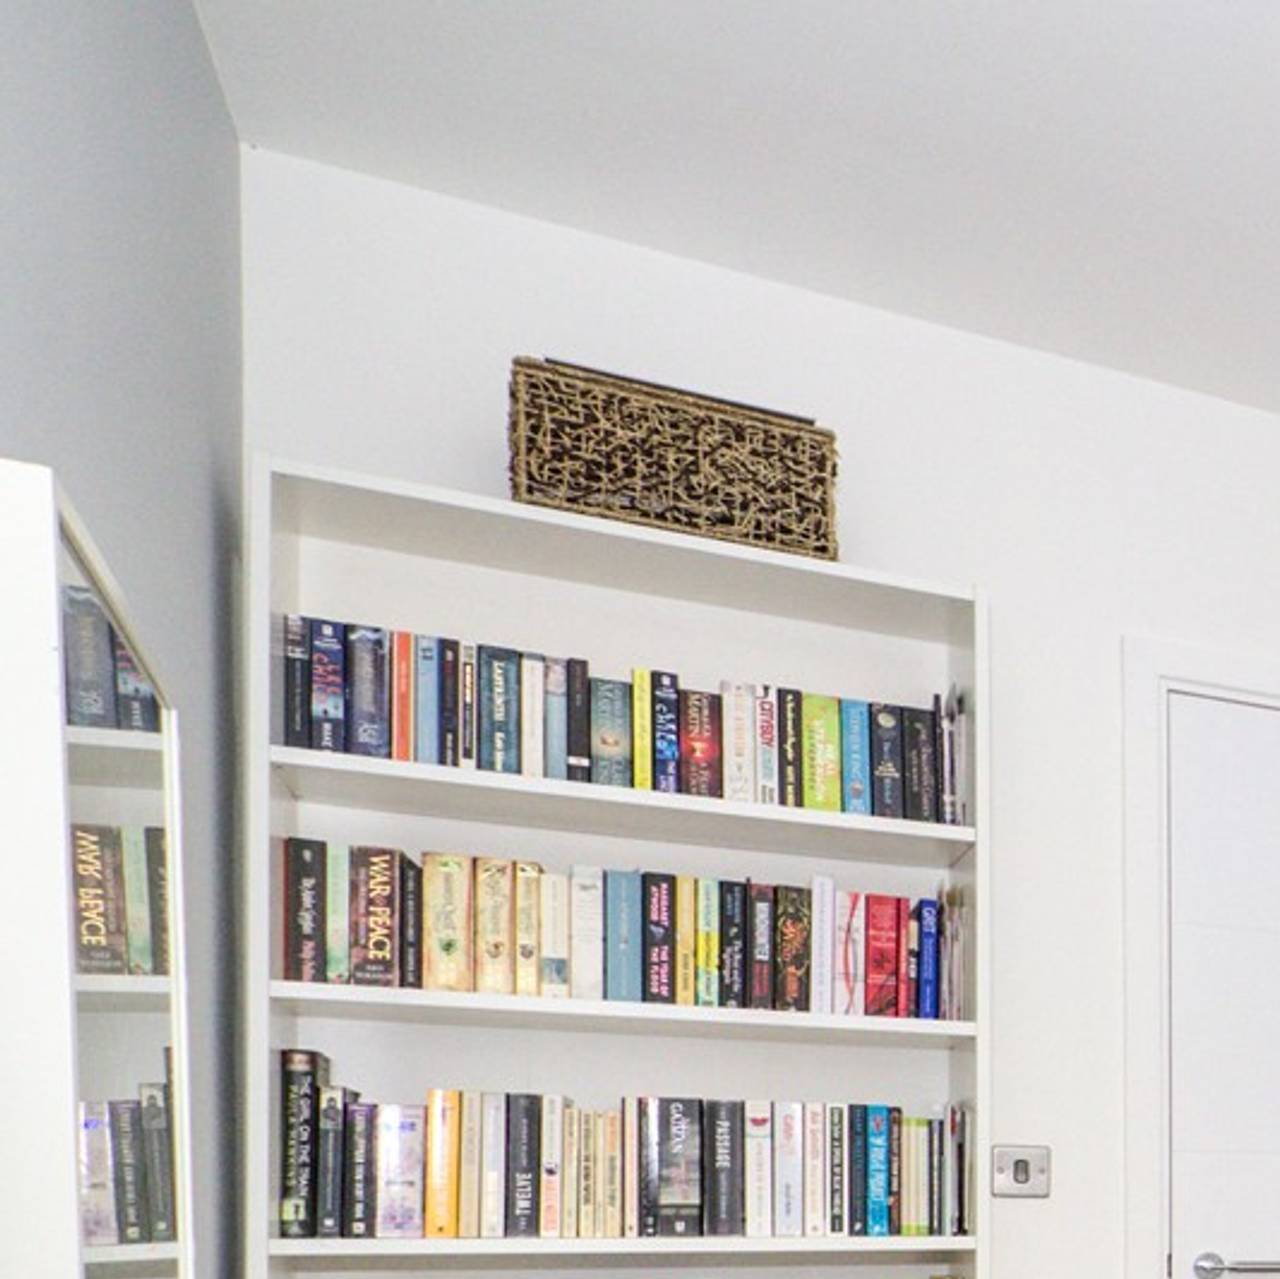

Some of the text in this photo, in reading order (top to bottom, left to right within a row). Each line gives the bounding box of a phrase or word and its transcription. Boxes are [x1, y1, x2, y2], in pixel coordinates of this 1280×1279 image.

[368, 853, 392, 898] WAR
[650, 885, 659, 922] ATWOOD
[922, 907, 936, 934] GRIT
[367, 905, 392, 961] PEACE
[650, 947, 659, 994] THE FLOOD
[660, 945, 668, 961] THE
[300, 1075, 312, 1095] THE
[287, 1085, 298, 1126] PAULA
[300, 1097, 312, 1123] GIRL
[300, 1145, 312, 1165] THE
[715, 1119, 731, 1169] PASSAGE
[299, 1167, 312, 1197] TRAIN
[515, 1172, 533, 1216] TWELVE
